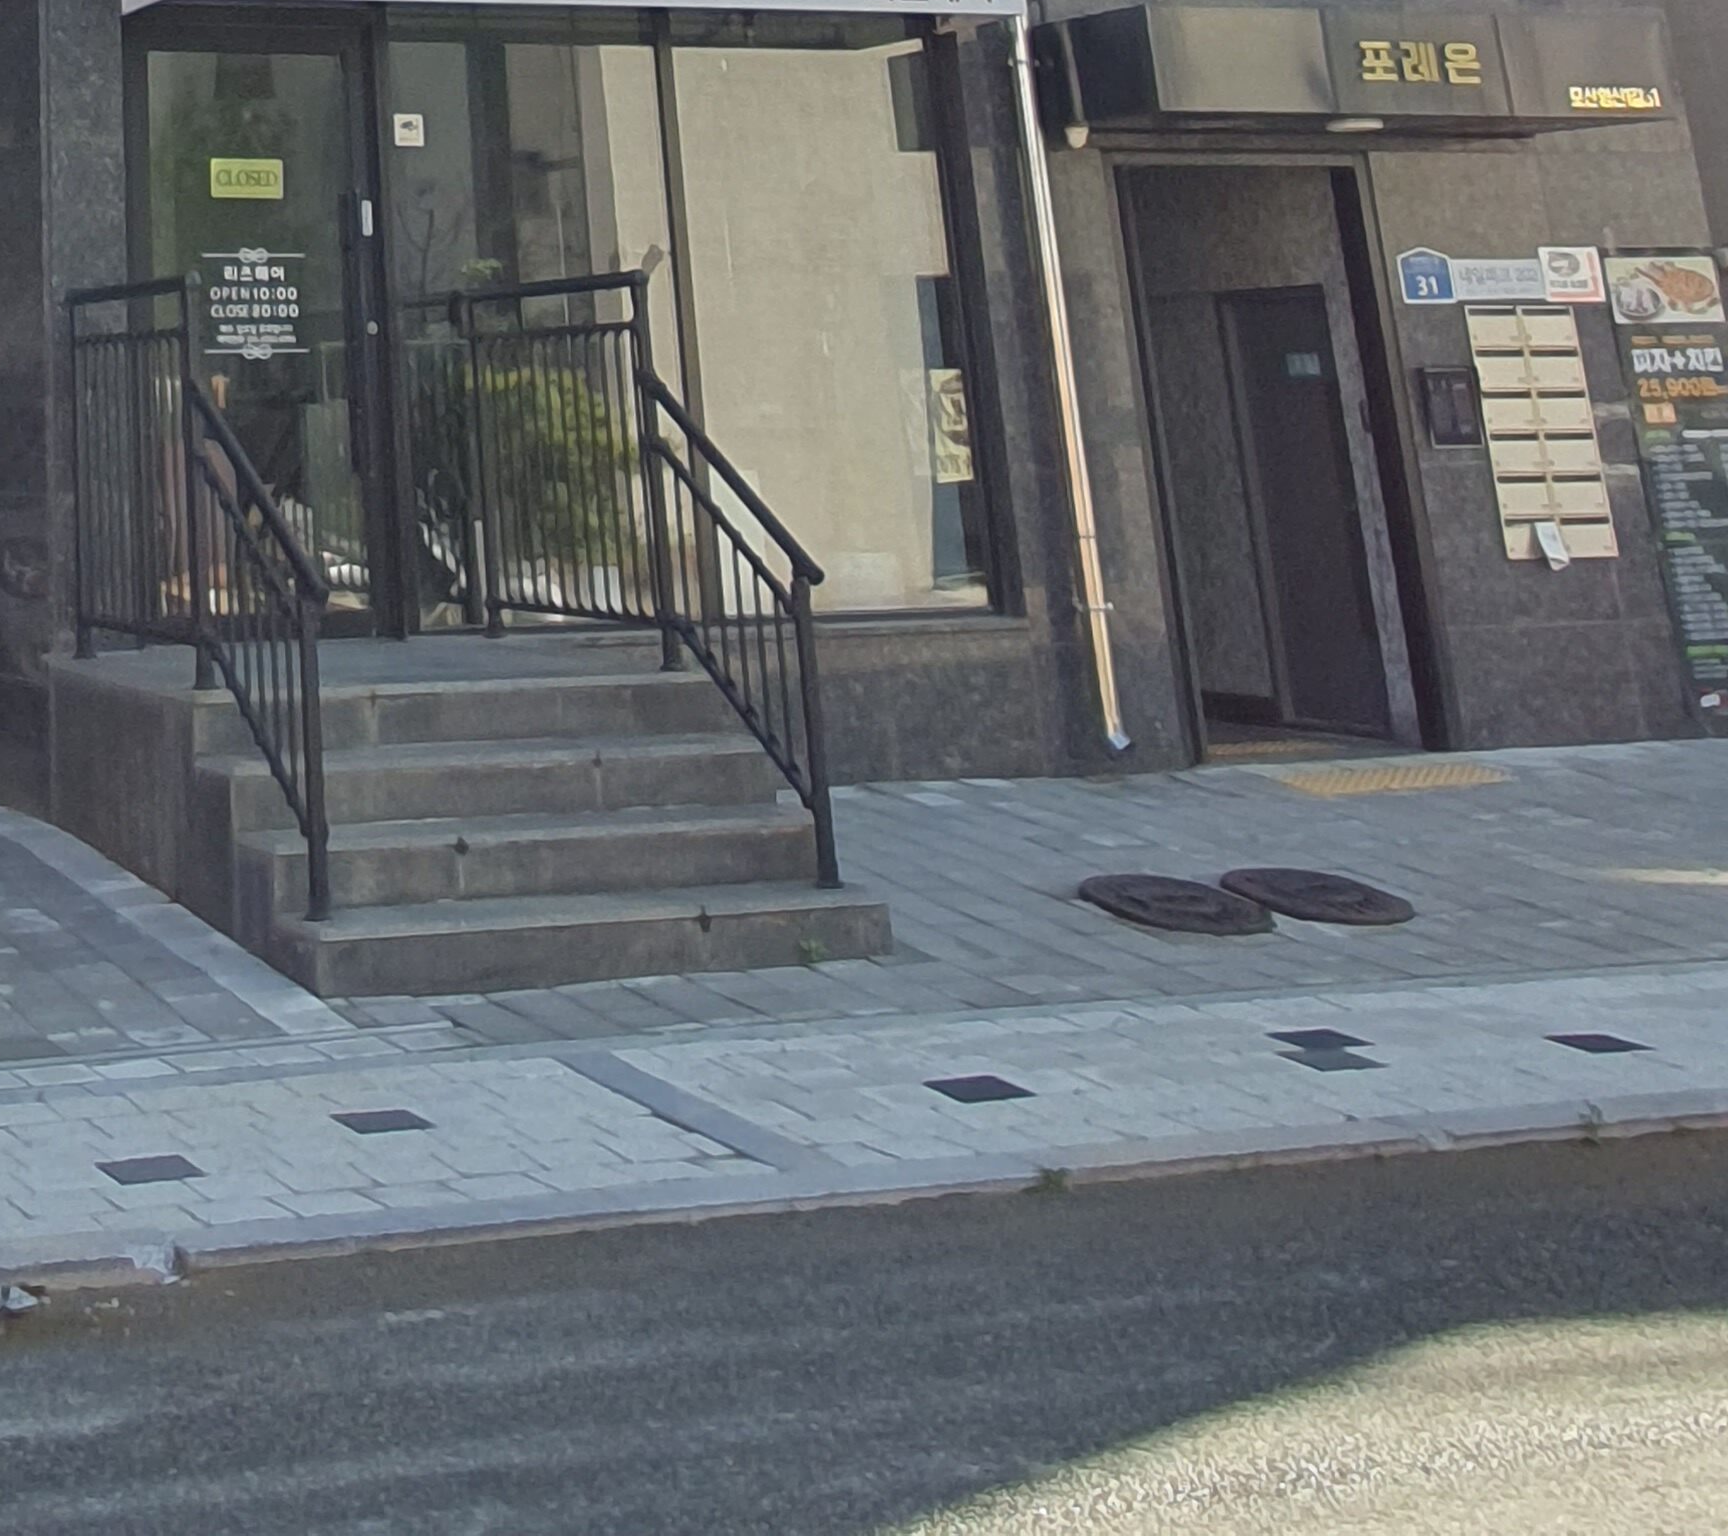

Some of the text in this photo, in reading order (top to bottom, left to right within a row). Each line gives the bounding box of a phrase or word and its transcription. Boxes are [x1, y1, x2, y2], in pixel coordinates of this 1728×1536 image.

[215, 169, 278, 187] CLOSED
[1415, 274, 1439, 296] 31
[210, 286, 298, 301] OPEN 10:00
[210, 304, 250, 318] CLOSE
